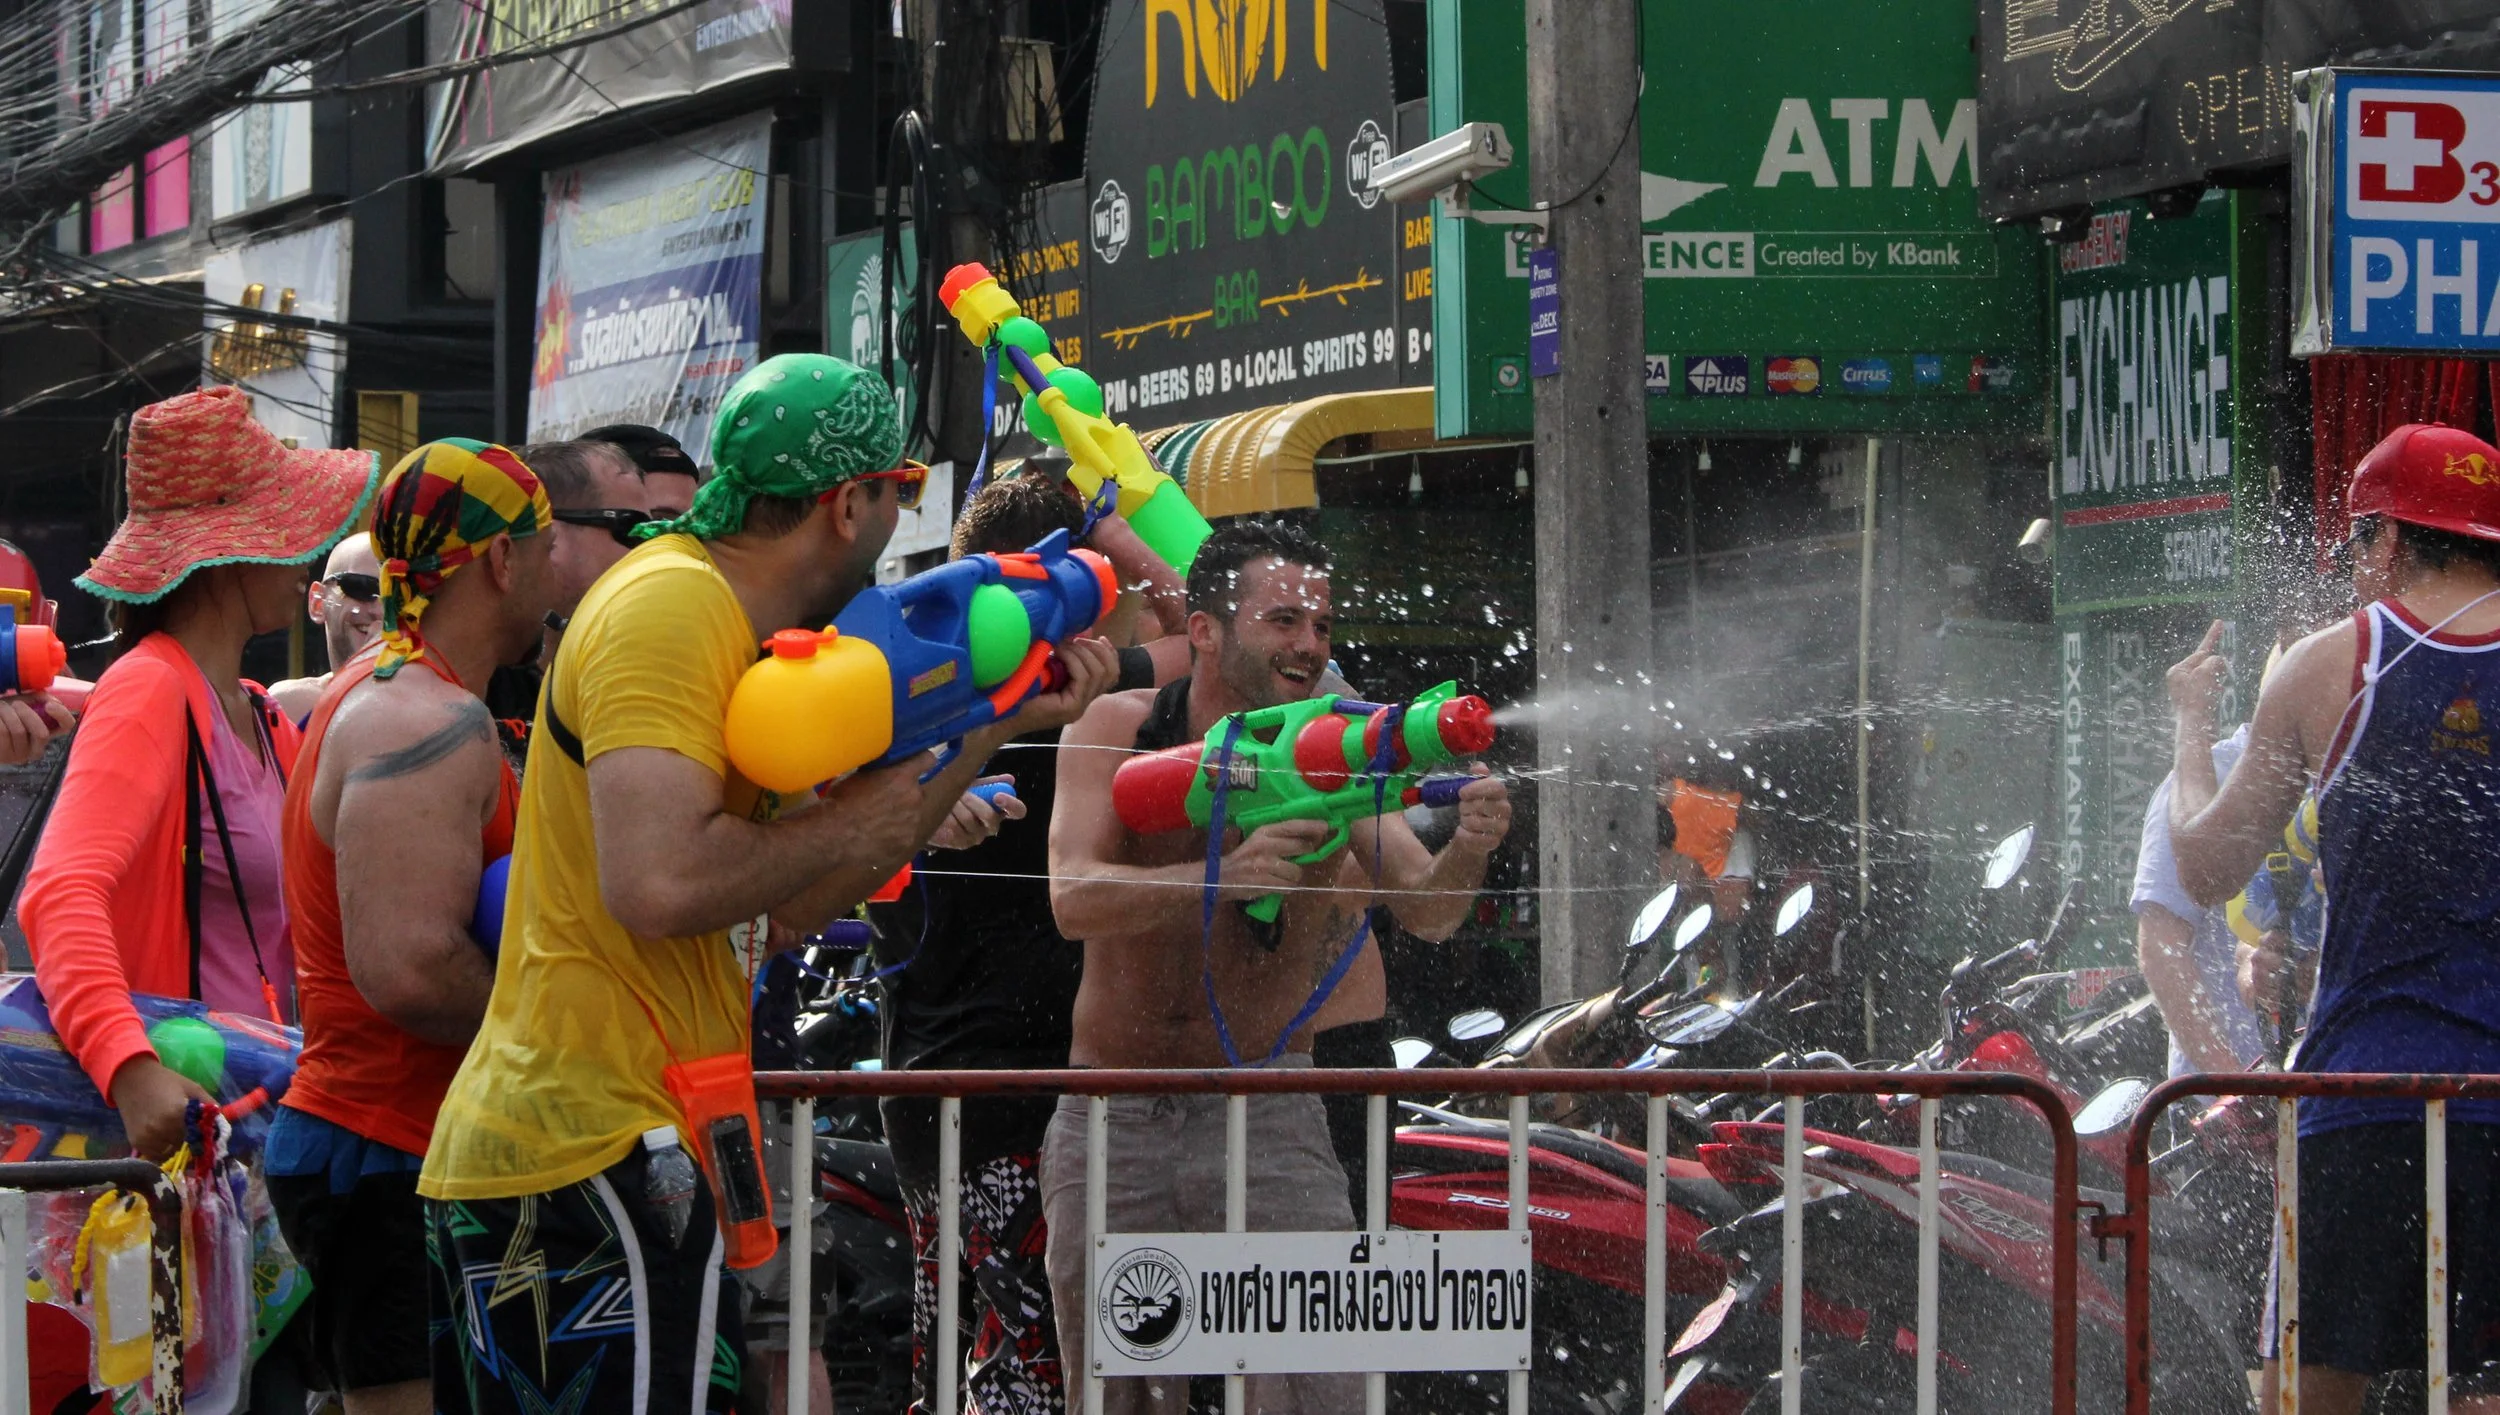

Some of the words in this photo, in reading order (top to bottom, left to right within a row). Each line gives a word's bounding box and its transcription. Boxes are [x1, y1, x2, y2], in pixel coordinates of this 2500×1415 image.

[2176, 60, 2290, 144] OPEN
[1362, 129, 1376, 144] Free
[1753, 98, 1978, 188] ATM
[709, 165, 757, 213] CLUB
[1146, 126, 1331, 259] BAMBOO
[662, 218, 752, 258] ENTERTAINMENT
[1405, 215, 1432, 249] BAR
[1761, 242, 1844, 266] Created
[1852, 242, 1878, 269] by
[1887, 242, 1960, 266] KBank
[1055, 288, 1080, 320] WIFI
[1214, 268, 1260, 329] BAR
[1405, 267, 1433, 301] LIVE
[1540, 311, 1556, 328] DECK
[1104, 379, 1128, 417] PM
[1140, 370, 1188, 408] BEERS
[1194, 361, 1215, 396] 69
[1220, 357, 1232, 392] B
[1244, 346, 1297, 389] LOCAL
[1302, 332, 1367, 378] SPIRITS
[1373, 326, 1396, 363] 99
[1407, 327, 1421, 364] B
[1704, 375, 1747, 394] PLUS
[1842, 367, 1888, 383] Cirrus
[2060, 275, 2230, 495] EXCHANGE
[2164, 524, 2230, 582] SERVICE
[2066, 632, 2083, 875] EXCHANG
[1447, 1191, 1510, 1209] PC
[1200, 1234, 1527, 1334] เทศบาลเมืองป่าตอง
